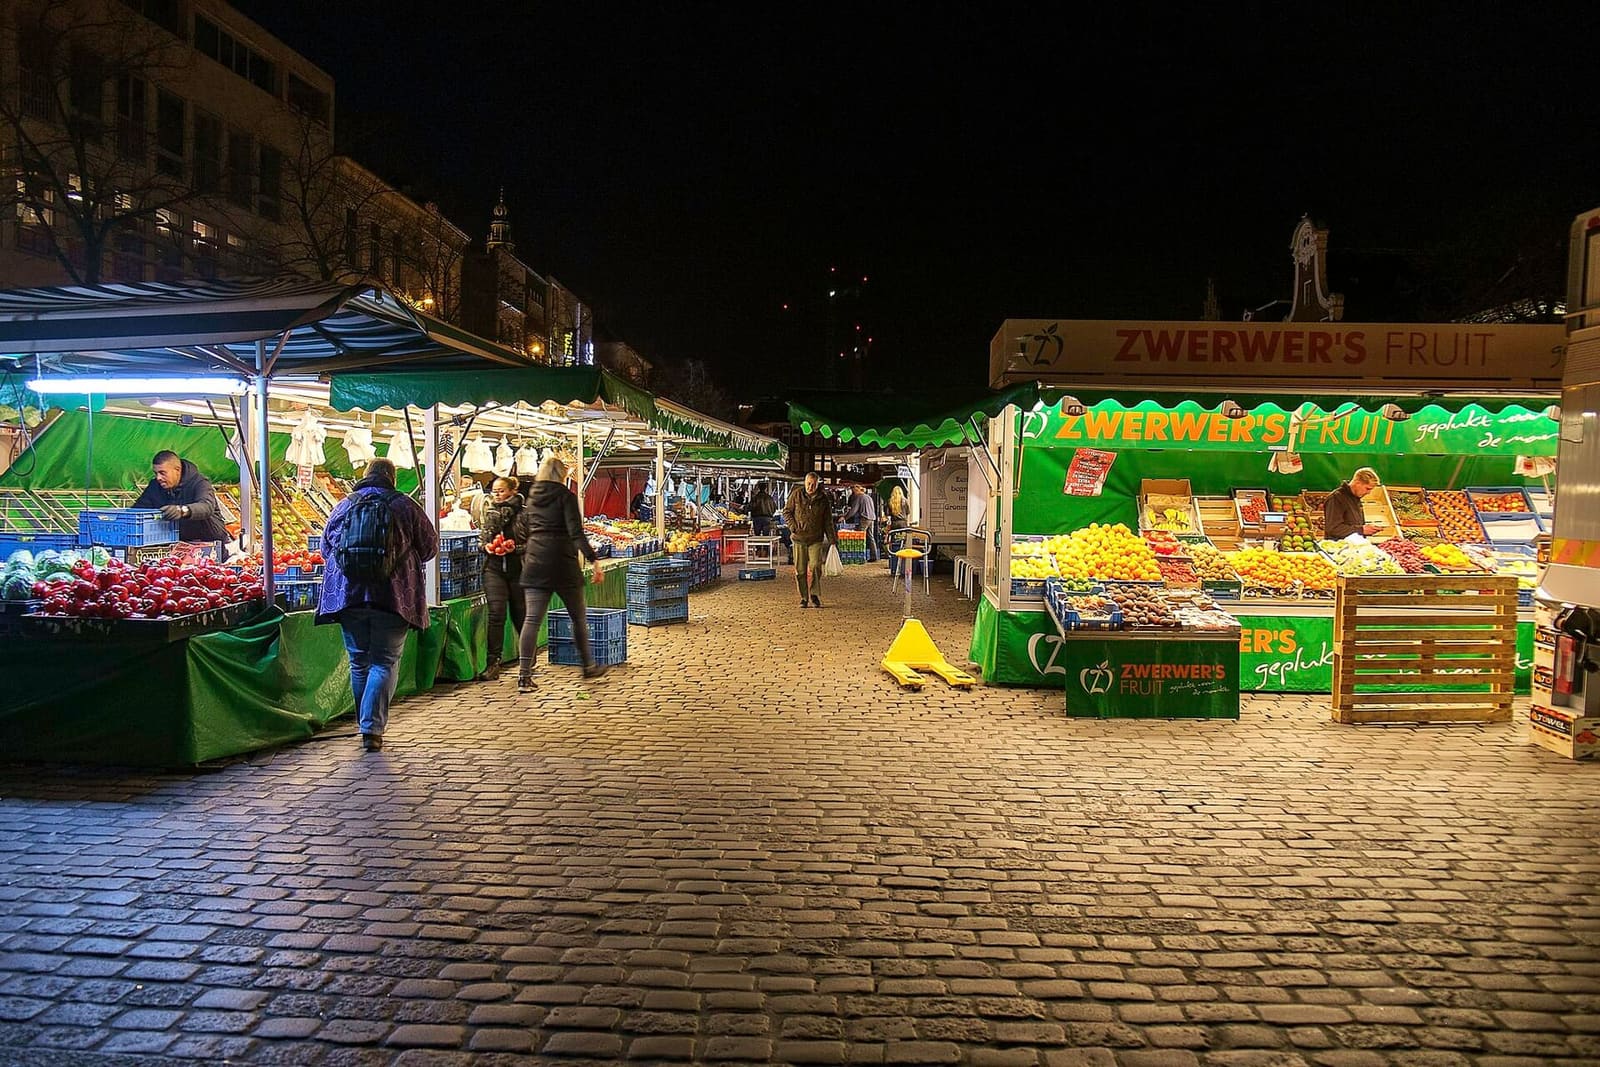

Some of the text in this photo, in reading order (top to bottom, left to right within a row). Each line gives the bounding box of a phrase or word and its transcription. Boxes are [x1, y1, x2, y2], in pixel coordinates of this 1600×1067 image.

[1114, 330, 1497, 367] ZWERWER'S FRUIT
[1055, 408, 1400, 445] ZWERWER'S FRUIT
[1240, 629, 1297, 654] ER'S
[1121, 664, 1226, 679] ZWERWER'S
[1255, 641, 1334, 690] gepluk
[1120, 680, 1164, 695] FRUIT
